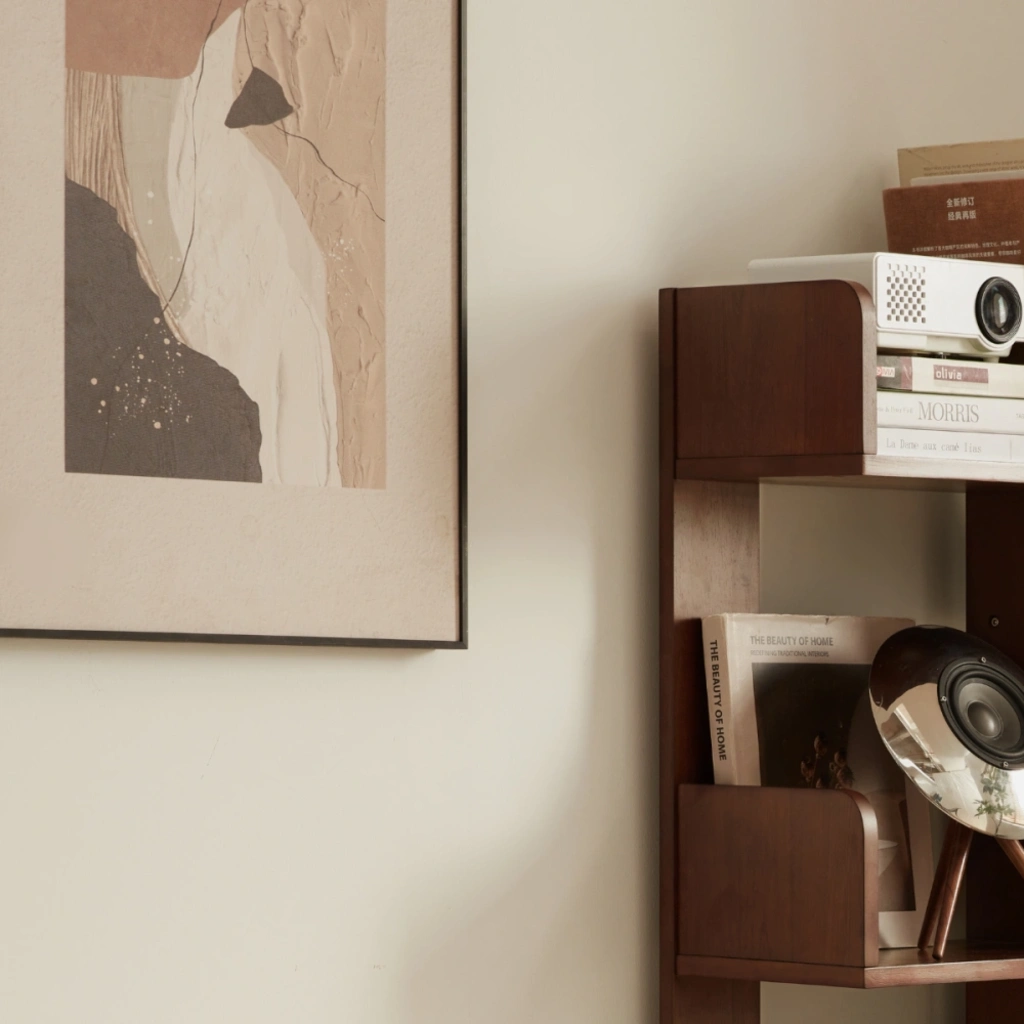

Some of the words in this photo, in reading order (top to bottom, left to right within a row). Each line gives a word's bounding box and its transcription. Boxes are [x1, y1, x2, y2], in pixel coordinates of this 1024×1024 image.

[946, 196, 975, 208] 全新修订
[947, 209, 977, 221] 经典再版
[935, 367, 962, 380] olivia
[917, 401, 980, 423] MORRIS
[886, 438, 896, 449] La
[900, 439, 919, 450] Dame
[922, 442, 937, 451] aux
[750, 636, 765, 645] THE
[767, 636, 797, 646] BEAUTY
[799, 636, 809, 646] OF
[811, 637, 834, 646] HOME
[709, 640, 719, 661] THE
[711, 664, 723, 707] BEAUTY
[715, 709, 724, 726] OF
[716, 727, 727, 761] HOME
